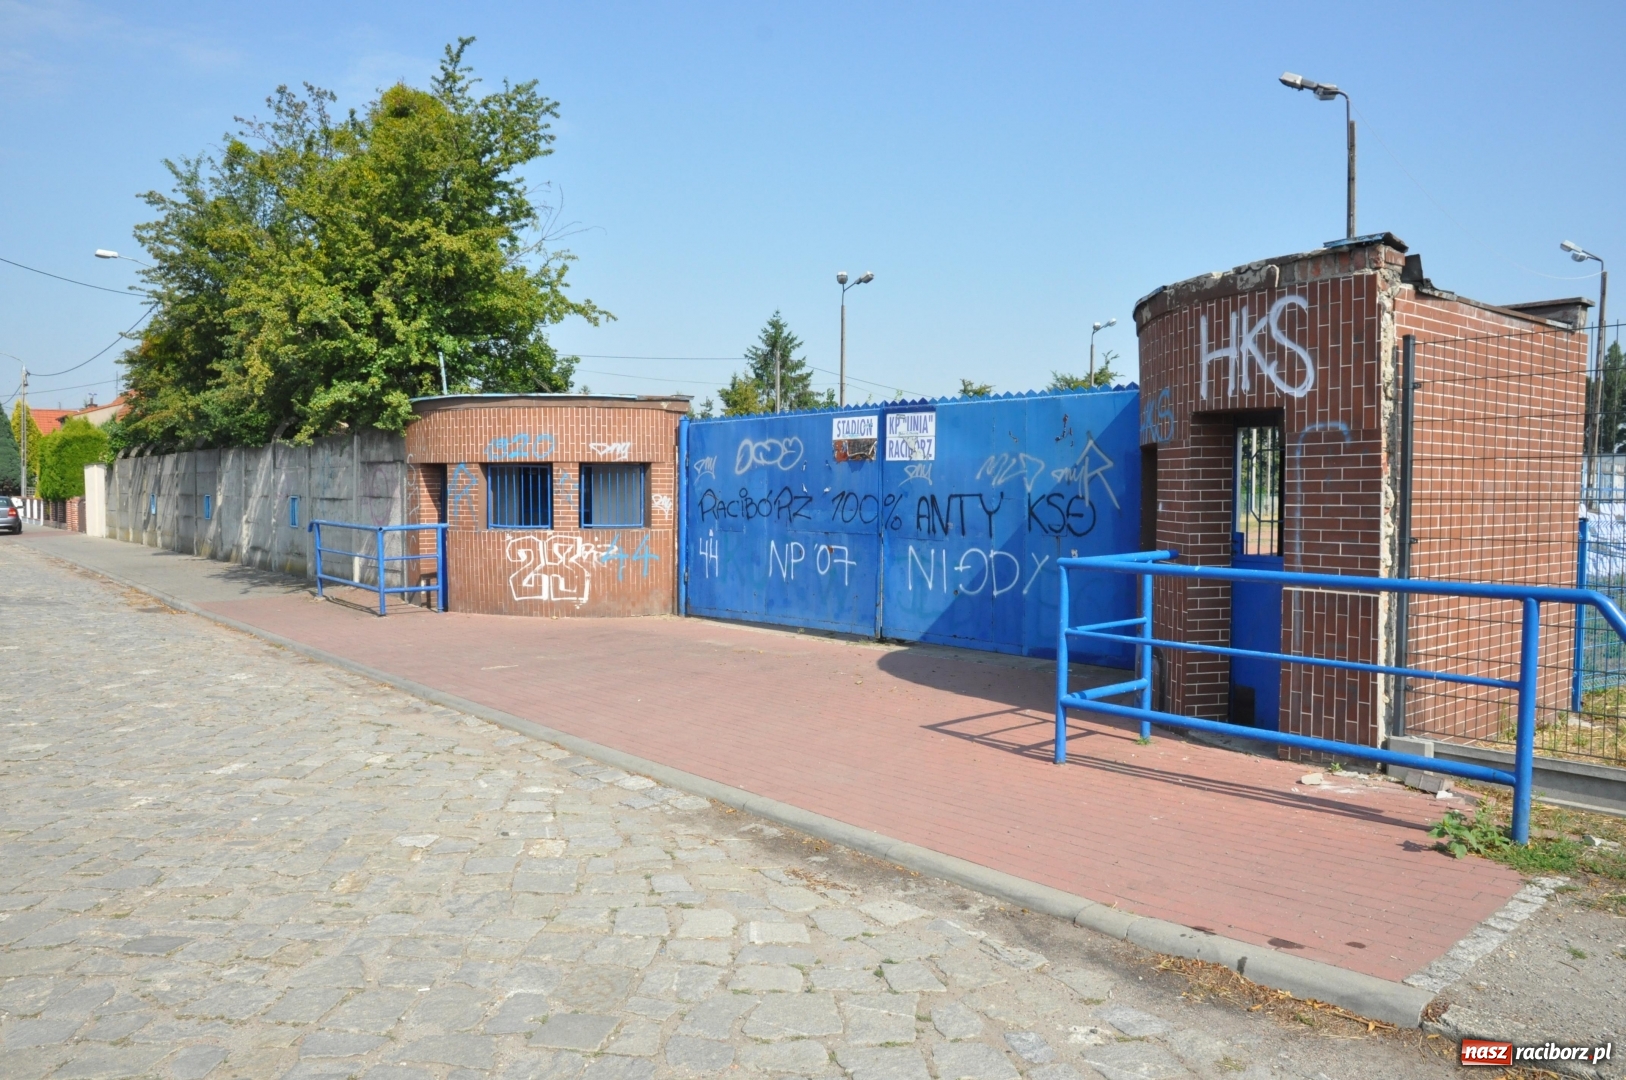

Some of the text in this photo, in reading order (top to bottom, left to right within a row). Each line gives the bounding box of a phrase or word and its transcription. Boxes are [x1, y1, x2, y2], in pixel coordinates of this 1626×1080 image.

[1199, 295, 1315, 399] HKS
[836, 418, 873, 438] STADION
[889, 416, 901, 435] KP
[832, 490, 902, 530] 100%
[917, 491, 1004, 539] ANTY
[601, 533, 660, 582] 44
[769, 539, 805, 582] NP
